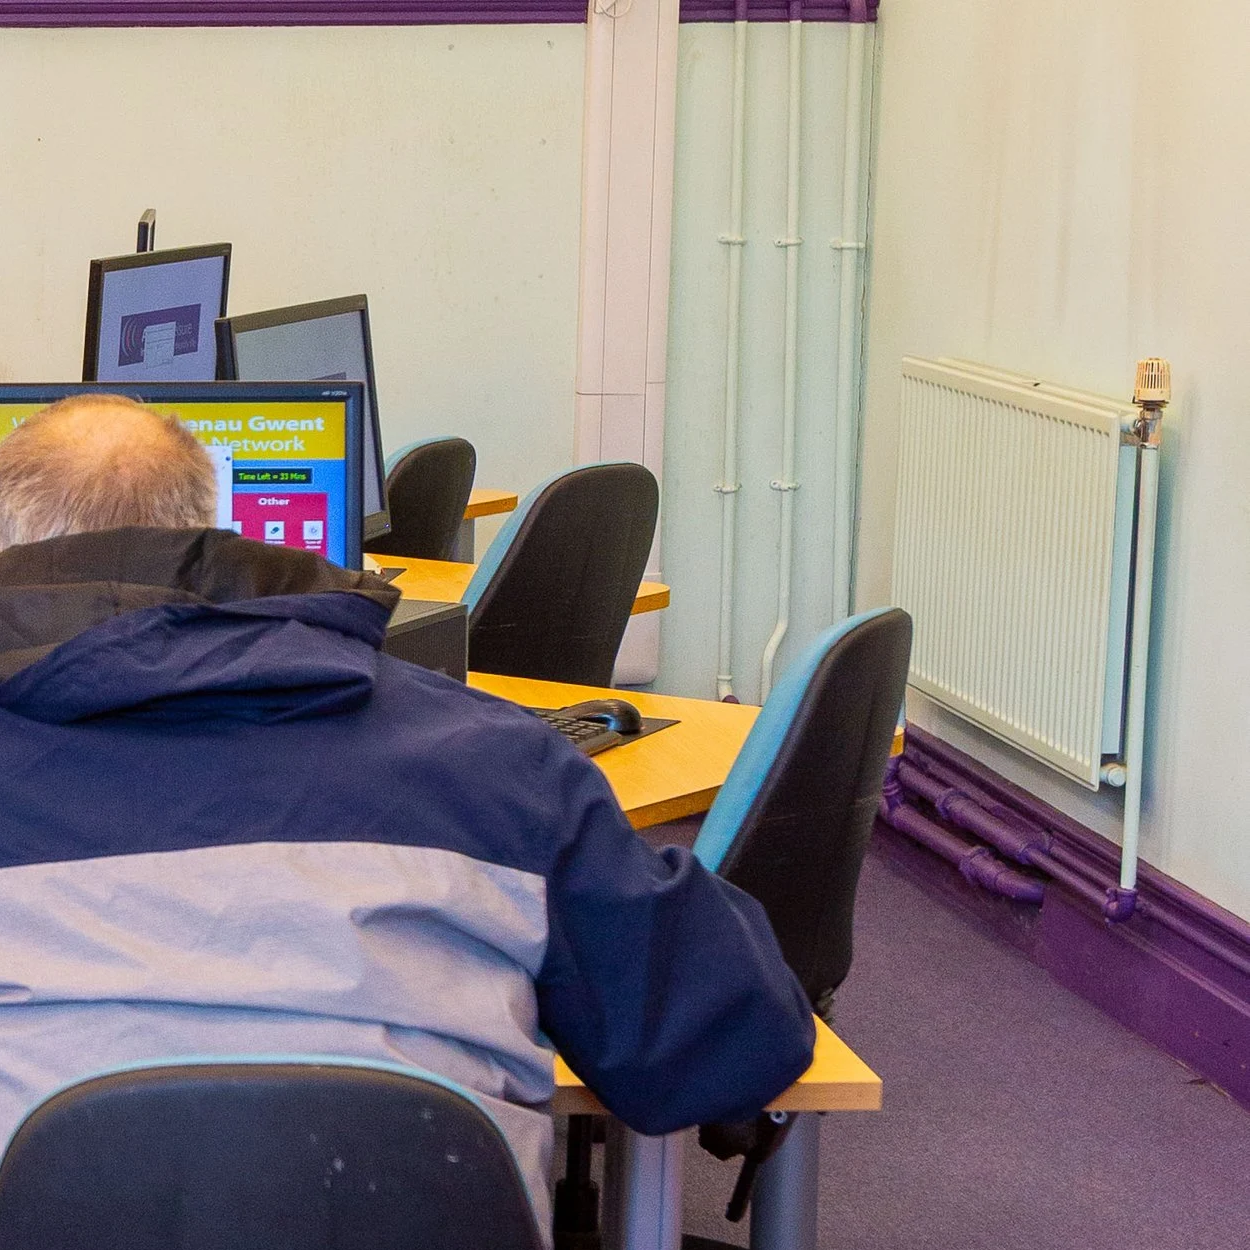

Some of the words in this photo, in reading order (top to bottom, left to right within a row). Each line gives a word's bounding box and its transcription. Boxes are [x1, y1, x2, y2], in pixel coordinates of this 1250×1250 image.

[187, 418, 243, 432] enau
[248, 415, 325, 432] Gwent
[211, 435, 306, 451] Network
[238, 472, 256, 481] Time
[257, 472, 271, 481] Left
[279, 472, 290, 481] 33
[290, 472, 307, 481] Mins
[257, 497, 290, 506] Other
